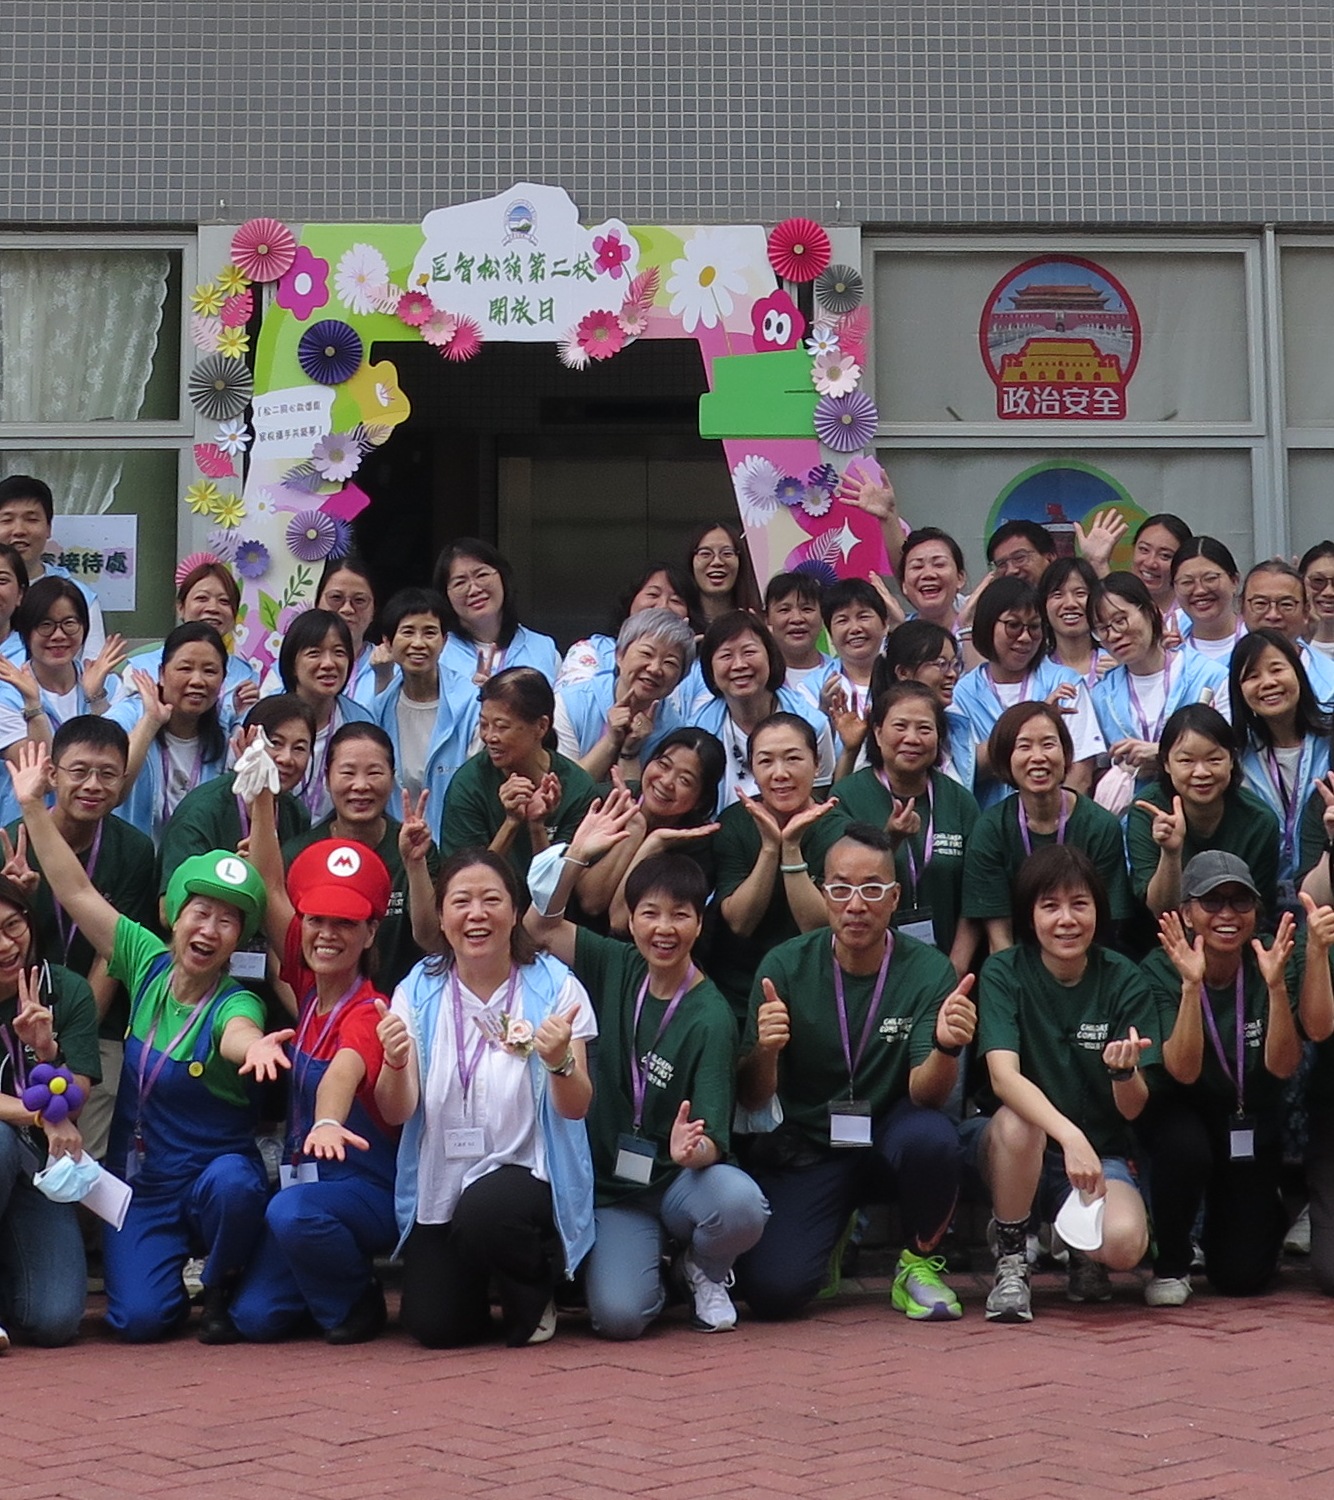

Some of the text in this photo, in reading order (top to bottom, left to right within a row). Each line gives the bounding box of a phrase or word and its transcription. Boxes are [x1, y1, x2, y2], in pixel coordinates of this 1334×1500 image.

[431, 251, 597, 285] 匡智松嶺第二校
[488, 294, 557, 327] 開放日
[1002, 386, 1120, 415] 政治安全
[224, 862, 237, 880] L
[333, 854, 353, 869] M
